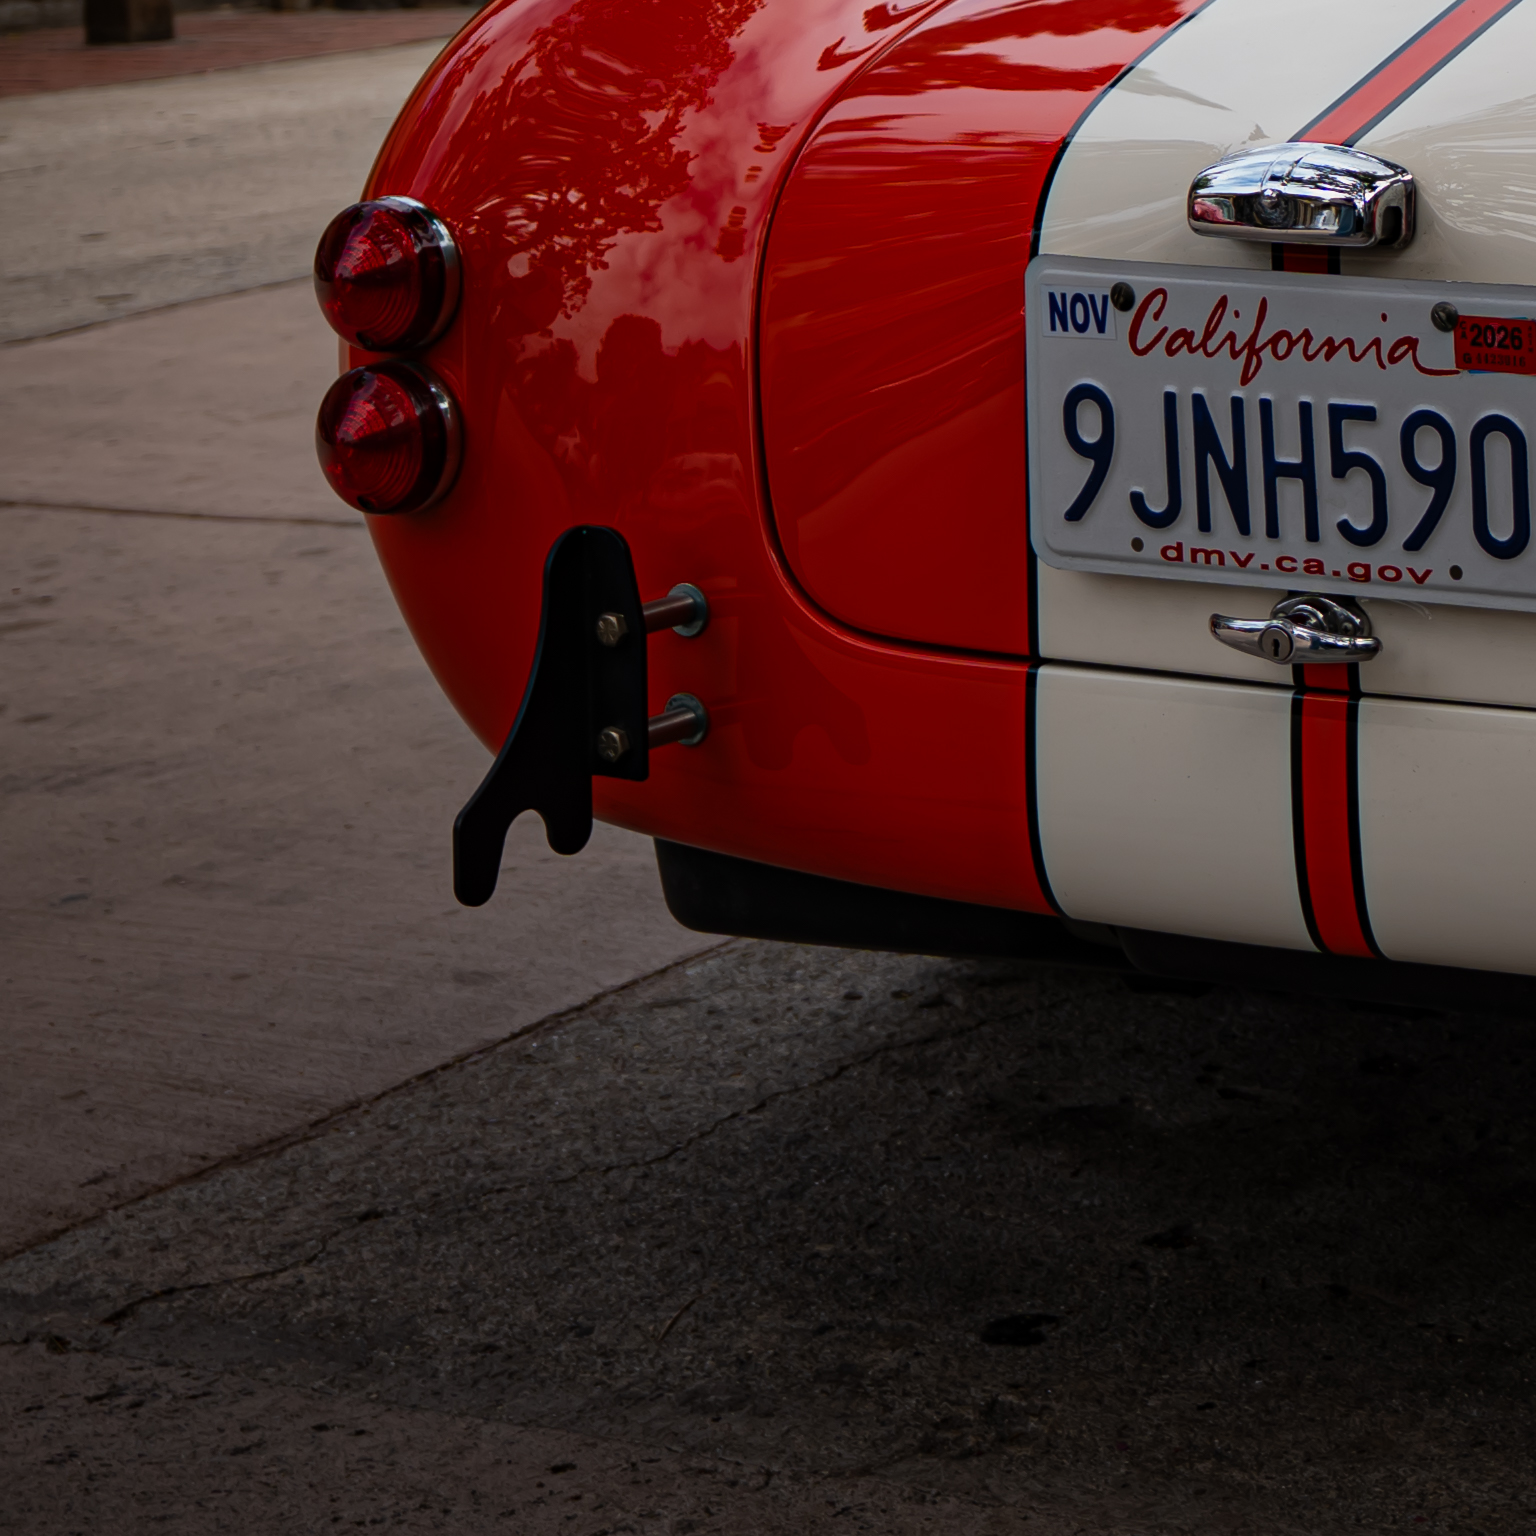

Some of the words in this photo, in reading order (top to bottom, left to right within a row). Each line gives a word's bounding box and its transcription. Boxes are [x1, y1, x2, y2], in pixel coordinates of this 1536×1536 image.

[1048, 291, 1109, 334] NOV
[1128, 287, 1461, 386] California
[1469, 322, 1524, 351] 2026
[1062, 382, 1532, 561] 9JNH590
[1160, 540, 1434, 585] dmv.ca.gov
